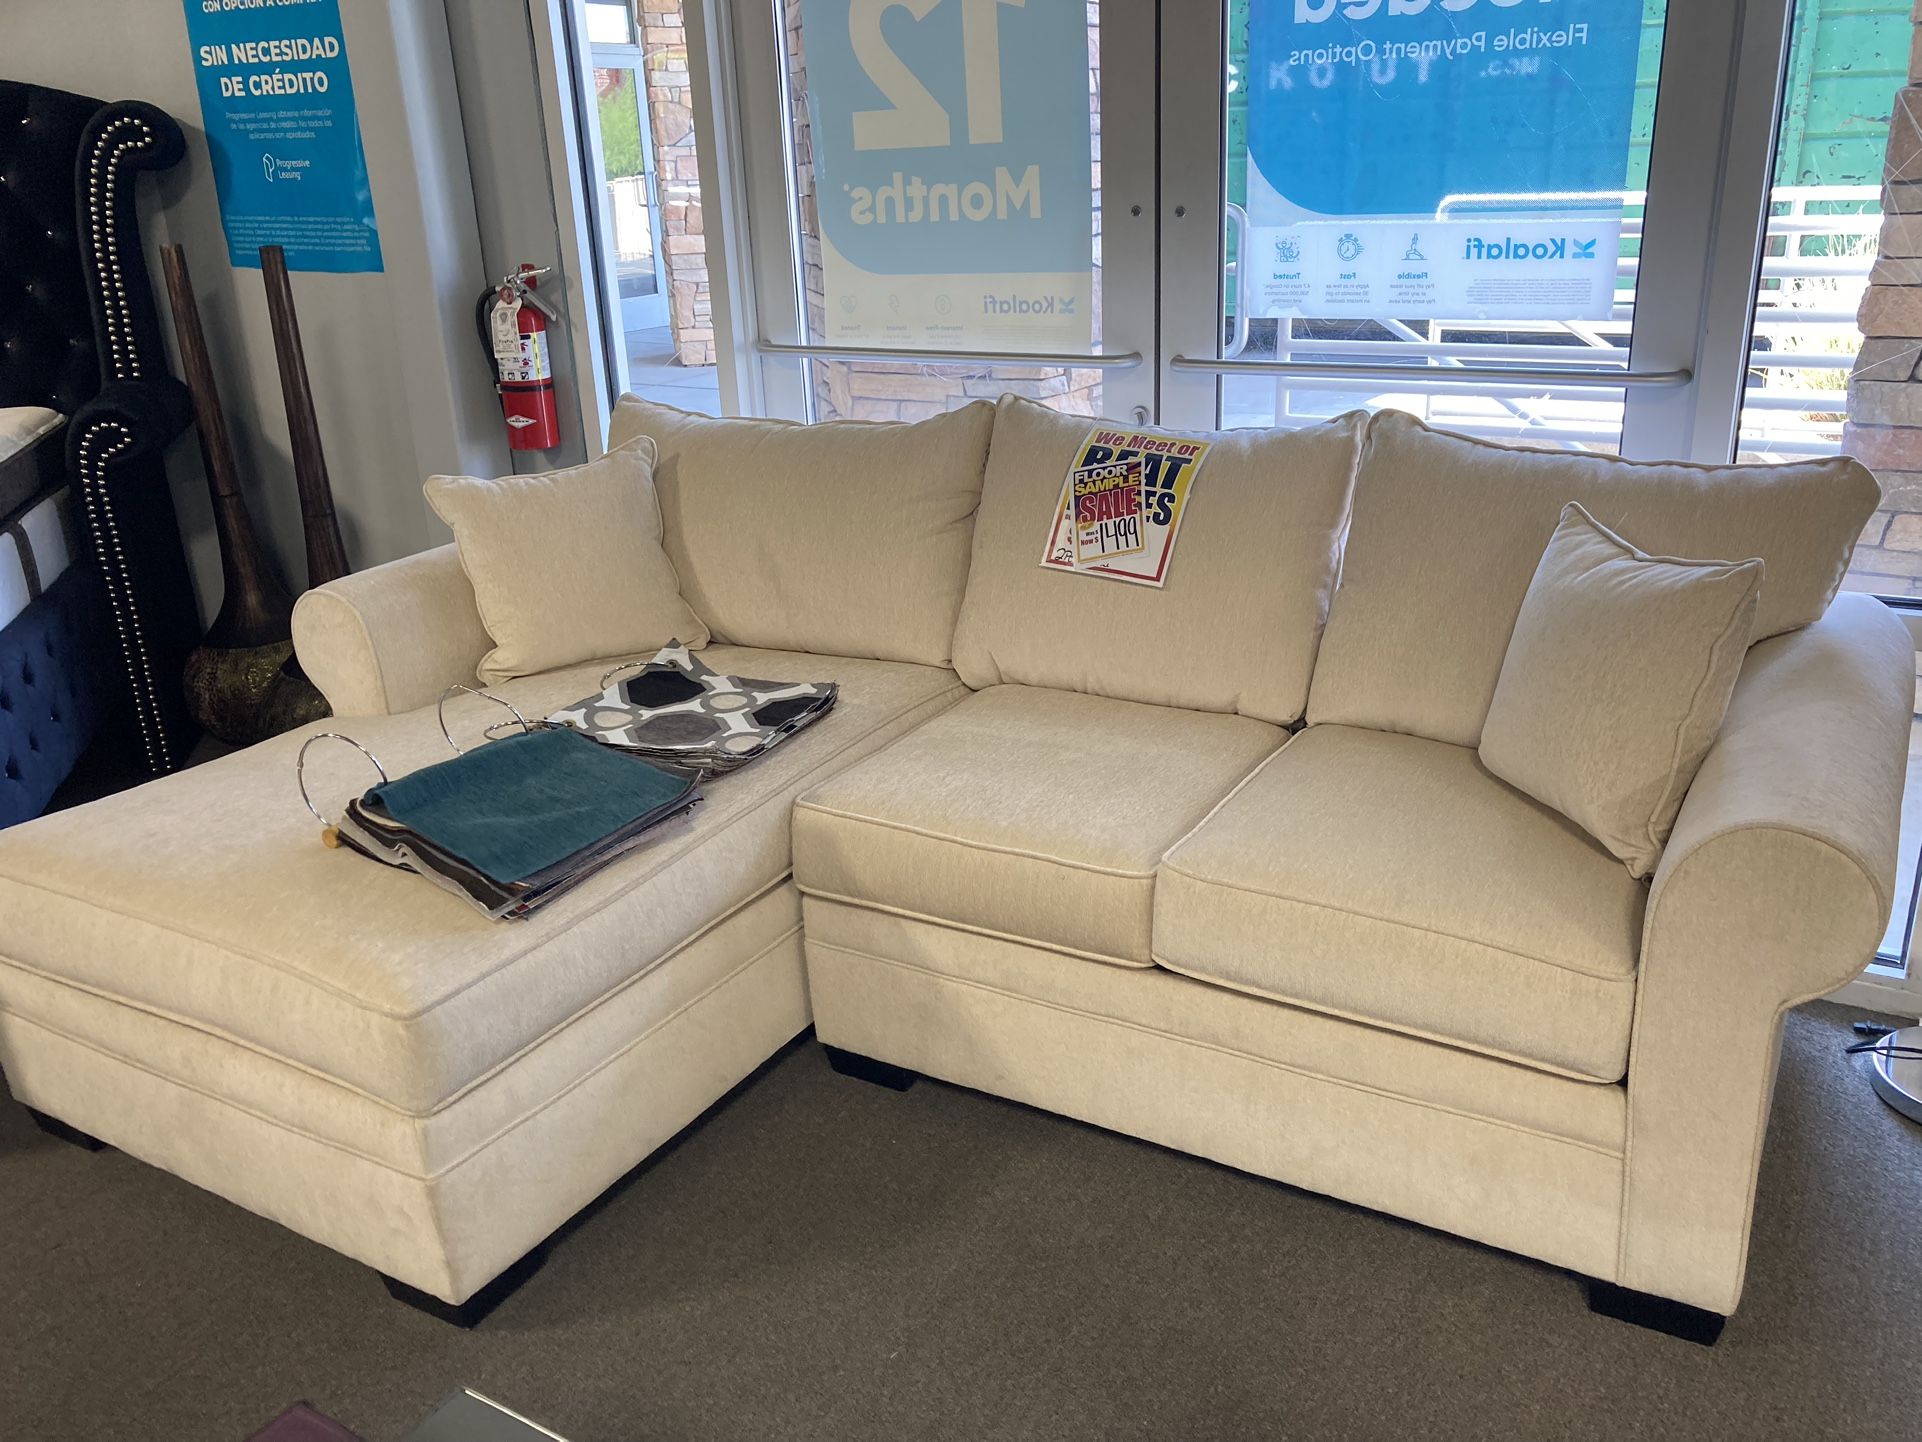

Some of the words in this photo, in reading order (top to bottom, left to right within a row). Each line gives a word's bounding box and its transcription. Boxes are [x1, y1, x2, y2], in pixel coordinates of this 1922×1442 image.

[202, 0, 220, 13] CON
[200, 45, 227, 66] SIN
[233, 36, 340, 64] NECESIDAD
[220, 76, 246, 97] DE
[249, 68, 329, 96] CRÉDITO
[276, 159, 310, 169] Progressive
[278, 170, 301, 180] Leasing
[1094, 431, 1126, 447] We
[1126, 435, 1176, 453] Meet
[1177, 443, 1201, 457] or
[1074, 464, 1128, 485] FLOOR
[1074, 473, 1141, 496] SAMPLE
[1080, 486, 1140, 524] SALE
[1081, 538, 1094, 546] Now
[1099, 516, 1140, 554] 1499
